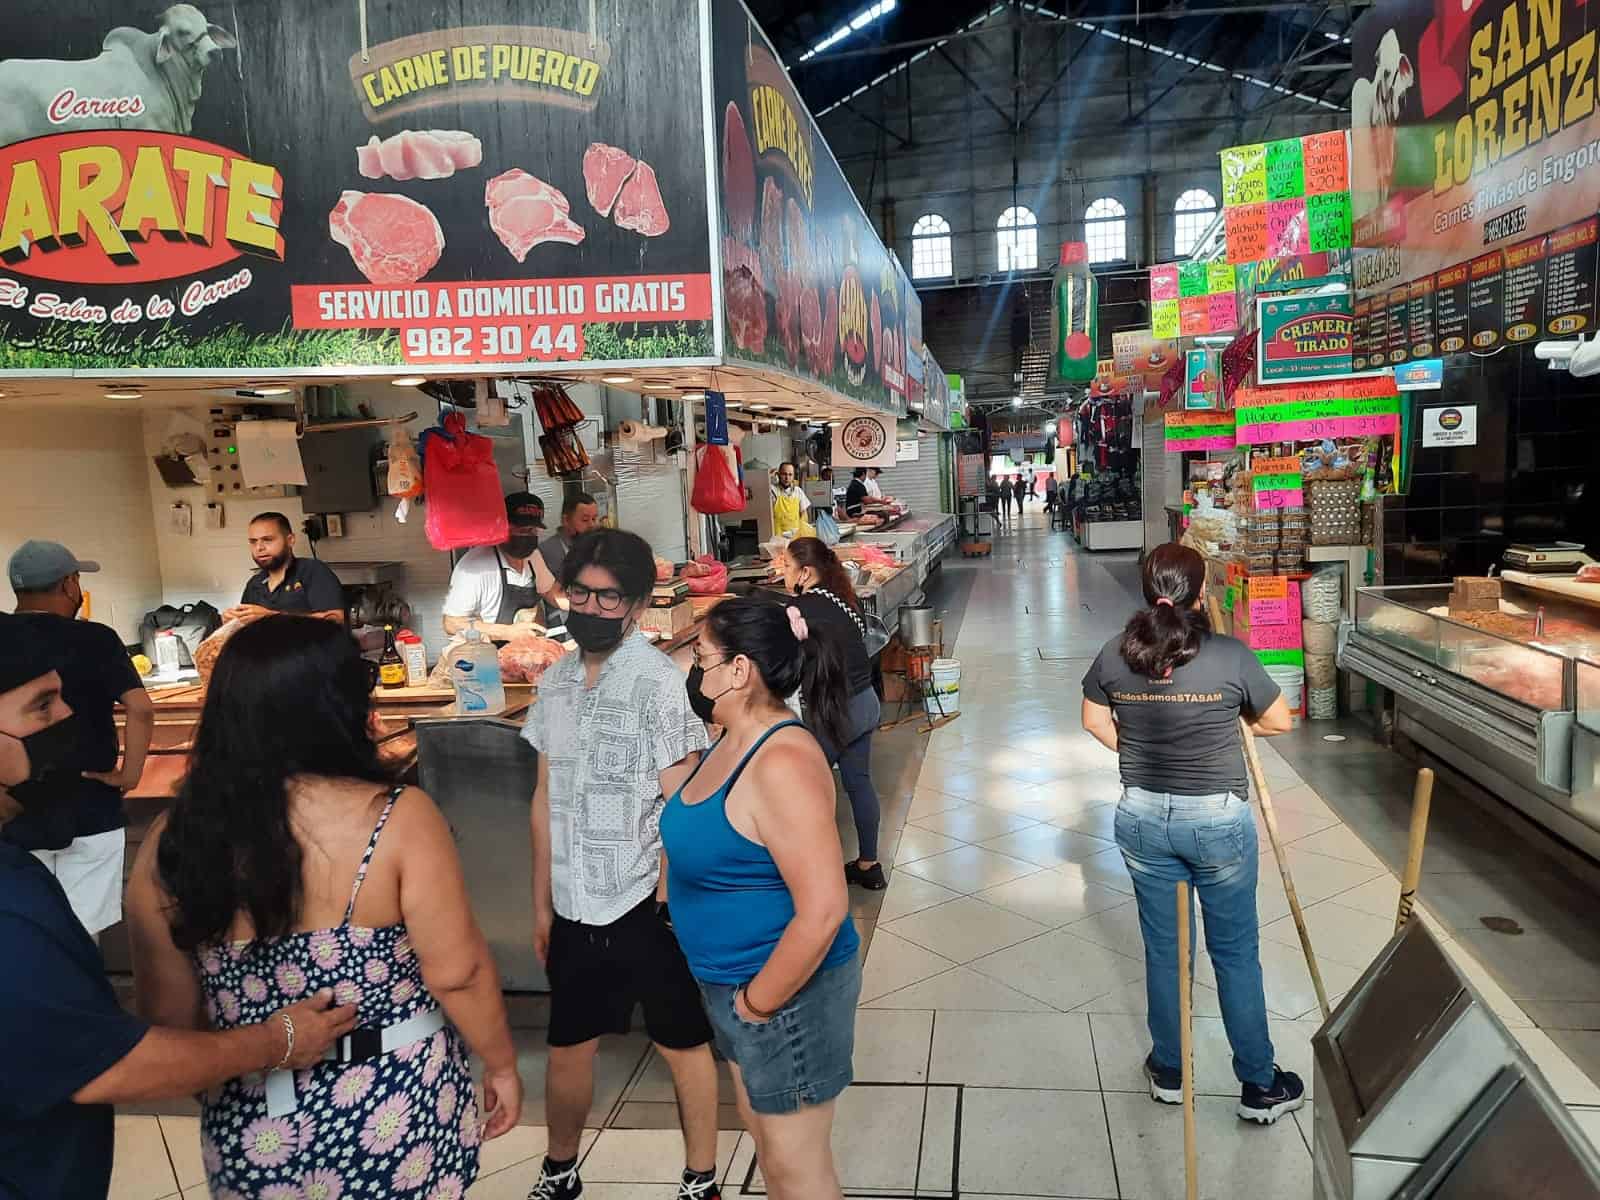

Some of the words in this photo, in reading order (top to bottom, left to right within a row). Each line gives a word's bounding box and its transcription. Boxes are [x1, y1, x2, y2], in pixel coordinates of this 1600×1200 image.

[361, 49, 449, 108] CARNE
[452, 44, 486, 81] DE
[492, 43, 600, 97] PUERCO
[1469, 0, 1561, 104] SAN
[47, 88, 146, 124] Carnes
[1433, 29, 1600, 199] LORENZ
[1432, 201, 1474, 235] Carnes
[1477, 182, 1514, 214] Finas
[1516, 167, 1538, 197] de
[0, 279, 28, 308] El
[29, 293, 108, 325] Sabor
[110, 299, 144, 325] de
[147, 293, 175, 320] la
[181, 267, 252, 316] Carne
[318, 288, 430, 320] SERVICIO
[434, 287, 453, 319] A
[457, 283, 586, 317] DOMICILIO
[594, 281, 686, 313] GRATIS
[406, 326, 473, 358] 982
[480, 324, 523, 356] 30
[529, 323, 579, 354] 44
[1280, 319, 1353, 341] CREMERI
[1295, 337, 1349, 353] TIRADO
